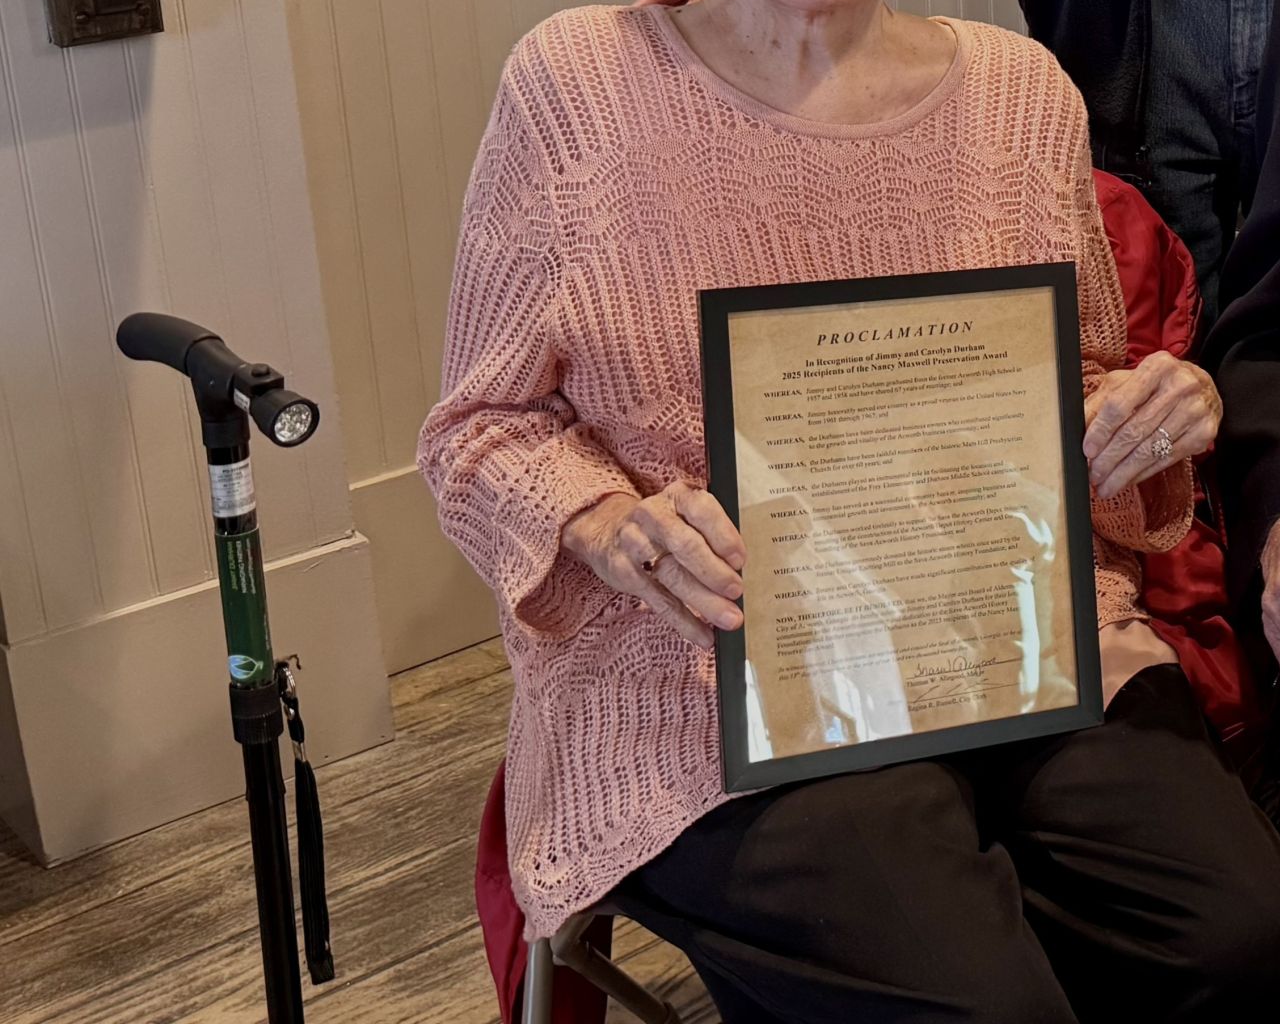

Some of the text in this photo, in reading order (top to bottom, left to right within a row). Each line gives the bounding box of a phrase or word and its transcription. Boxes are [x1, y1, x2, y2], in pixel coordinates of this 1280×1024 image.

[817, 320, 974, 346] PROCLAMATION
[782, 351, 1008, 381] 2025 Recipients of the Nancy Maxwell Preservation Award
[806, 344, 985, 368] In Recognition of Jimmy and Carolyn Durham
